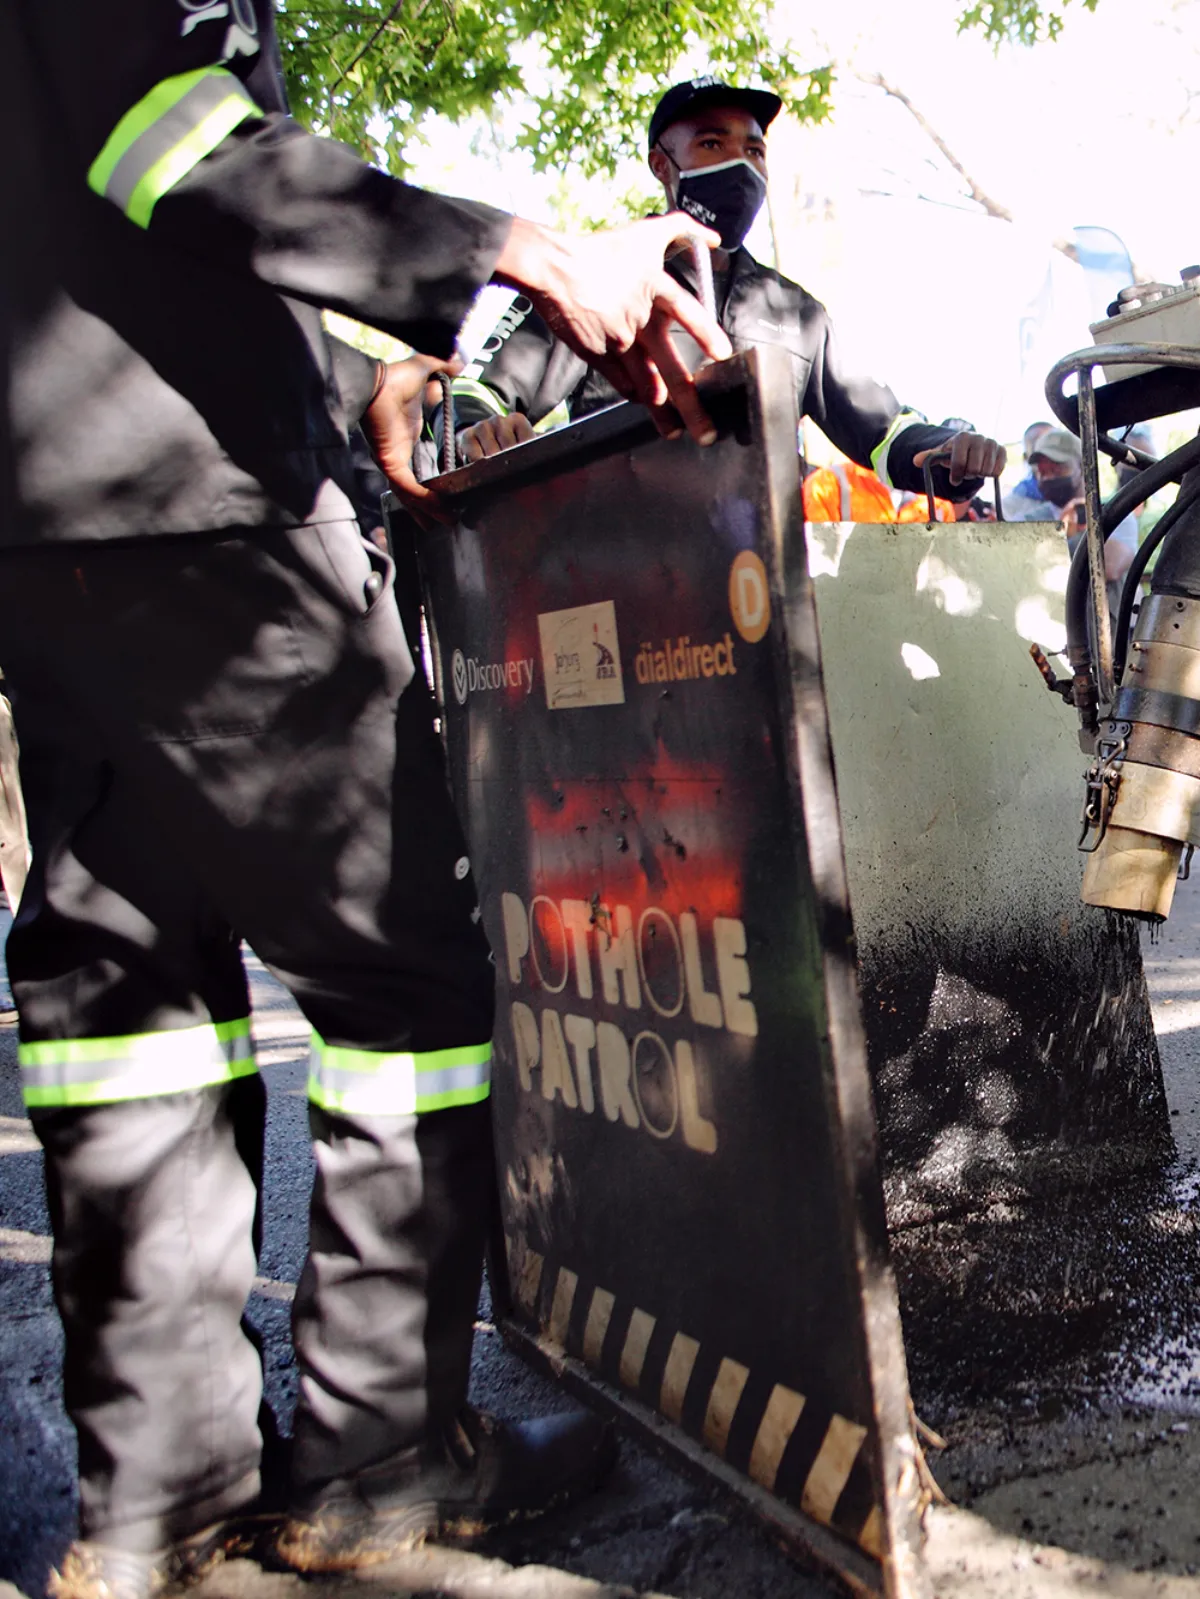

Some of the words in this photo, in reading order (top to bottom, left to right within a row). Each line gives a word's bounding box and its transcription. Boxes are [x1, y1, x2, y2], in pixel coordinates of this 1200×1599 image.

[467, 655, 534, 694] Discovery
[635, 633, 738, 685] dialdirect
[502, 892, 759, 1037] POTHOLE
[512, 1001, 718, 1154] PATROL
